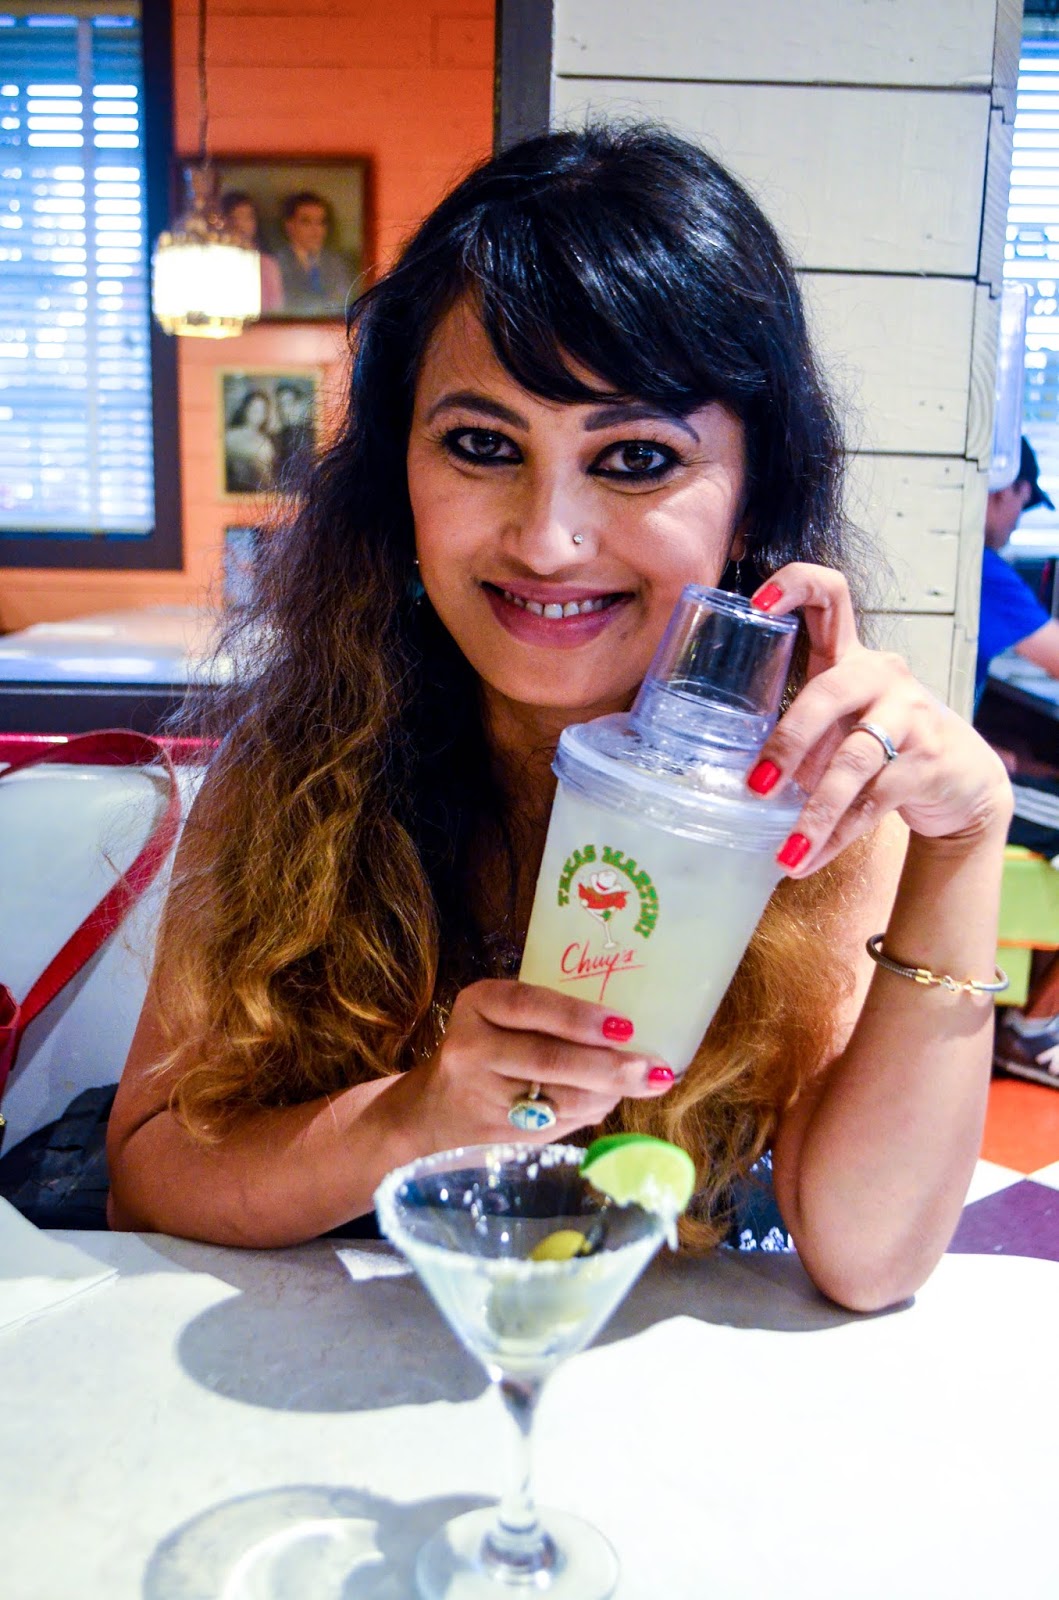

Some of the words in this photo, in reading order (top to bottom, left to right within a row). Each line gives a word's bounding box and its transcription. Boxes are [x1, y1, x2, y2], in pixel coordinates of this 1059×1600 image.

[558, 844, 597, 907] TEXAS
[601, 845, 660, 939] MARTINI
[560, 939, 642, 999] Chuy's
